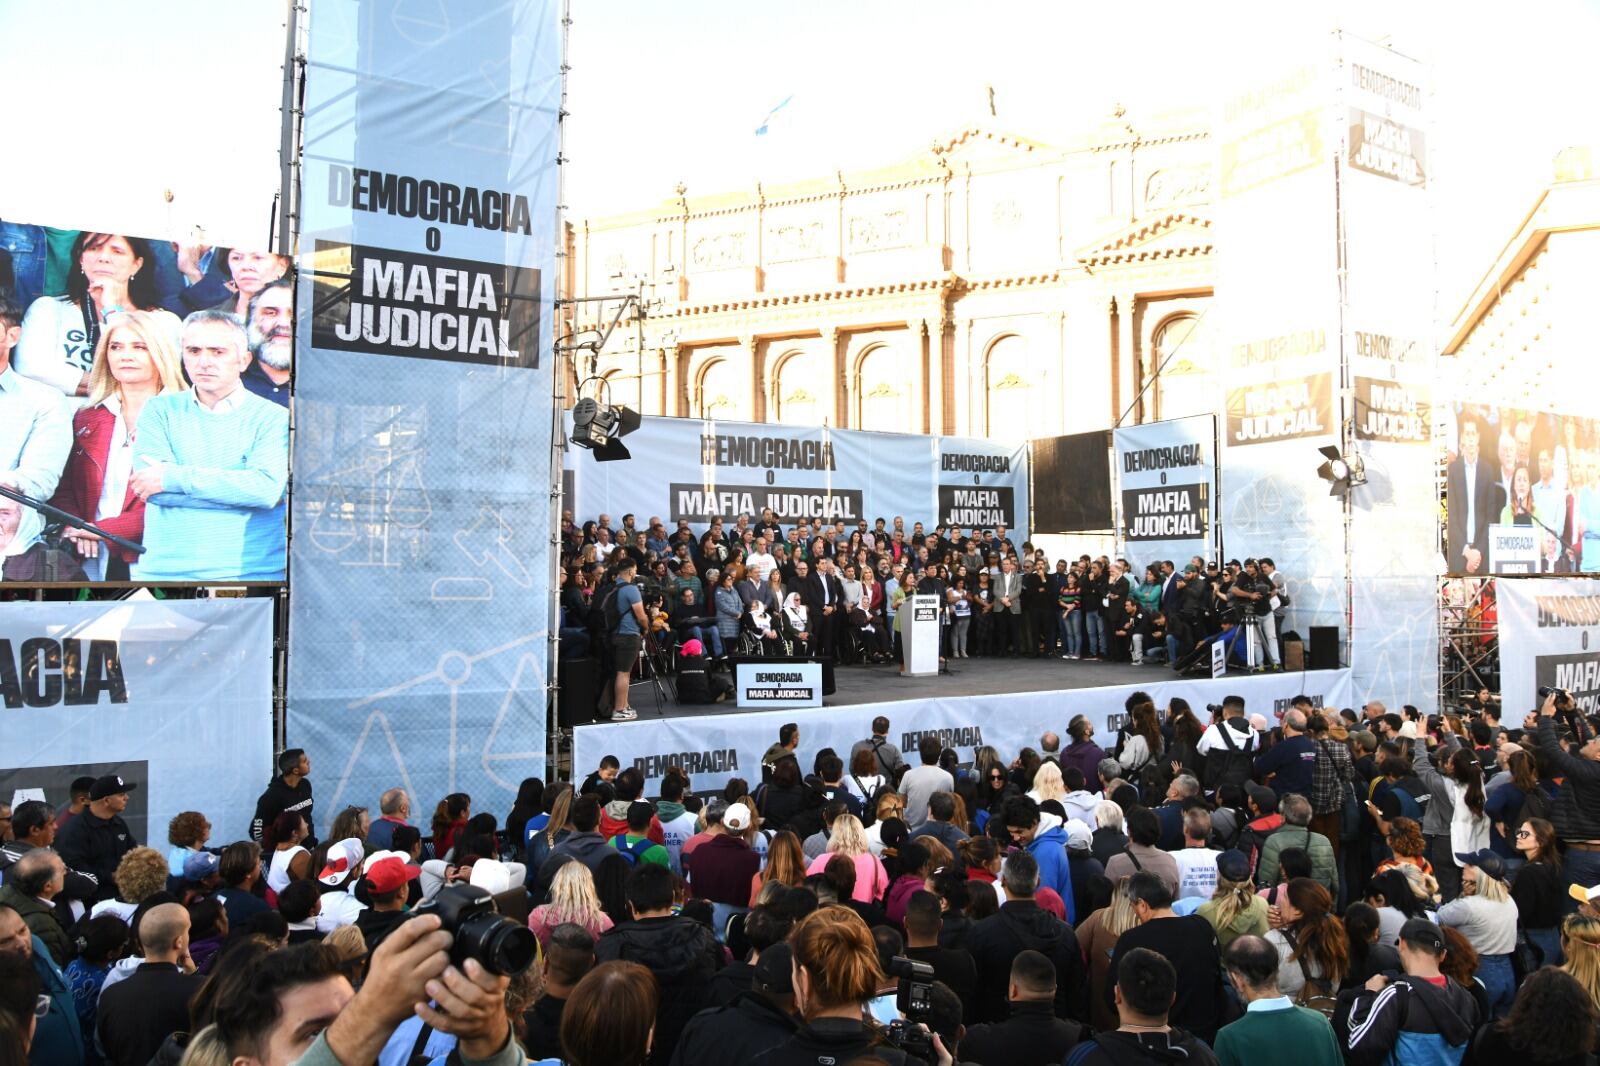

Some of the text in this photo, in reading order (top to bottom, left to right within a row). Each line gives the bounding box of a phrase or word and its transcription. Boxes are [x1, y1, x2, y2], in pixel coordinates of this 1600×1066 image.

[328, 164, 532, 236] DEMOCRACIA
[425, 227, 441, 252] O
[362, 257, 498, 312] MAFIA
[335, 302, 520, 358] JUDICIAL
[1236, 408, 1323, 440] JUDICIAL
[700, 434, 836, 471] DEMOCRACIA
[942, 453, 1010, 473] DEMOCRACIA
[1124, 443, 1203, 473] DEMOCRACIA
[766, 470, 774, 485] O
[974, 474, 980, 485] O
[1160, 472, 1167, 485] O
[678, 490, 856, 519] MAFIA JUDICIAL
[954, 490, 999, 508] MAFIA
[1138, 490, 1191, 514] MAFIA
[946, 509, 1008, 526] JUDICIAL
[1129, 513, 1200, 537] JUDICIAL
[1582, 630, 1589, 651] O
[755, 672, 803, 683] DEMOCRACIA
[748, 689, 810, 698] MAFIA JUDICIAL
